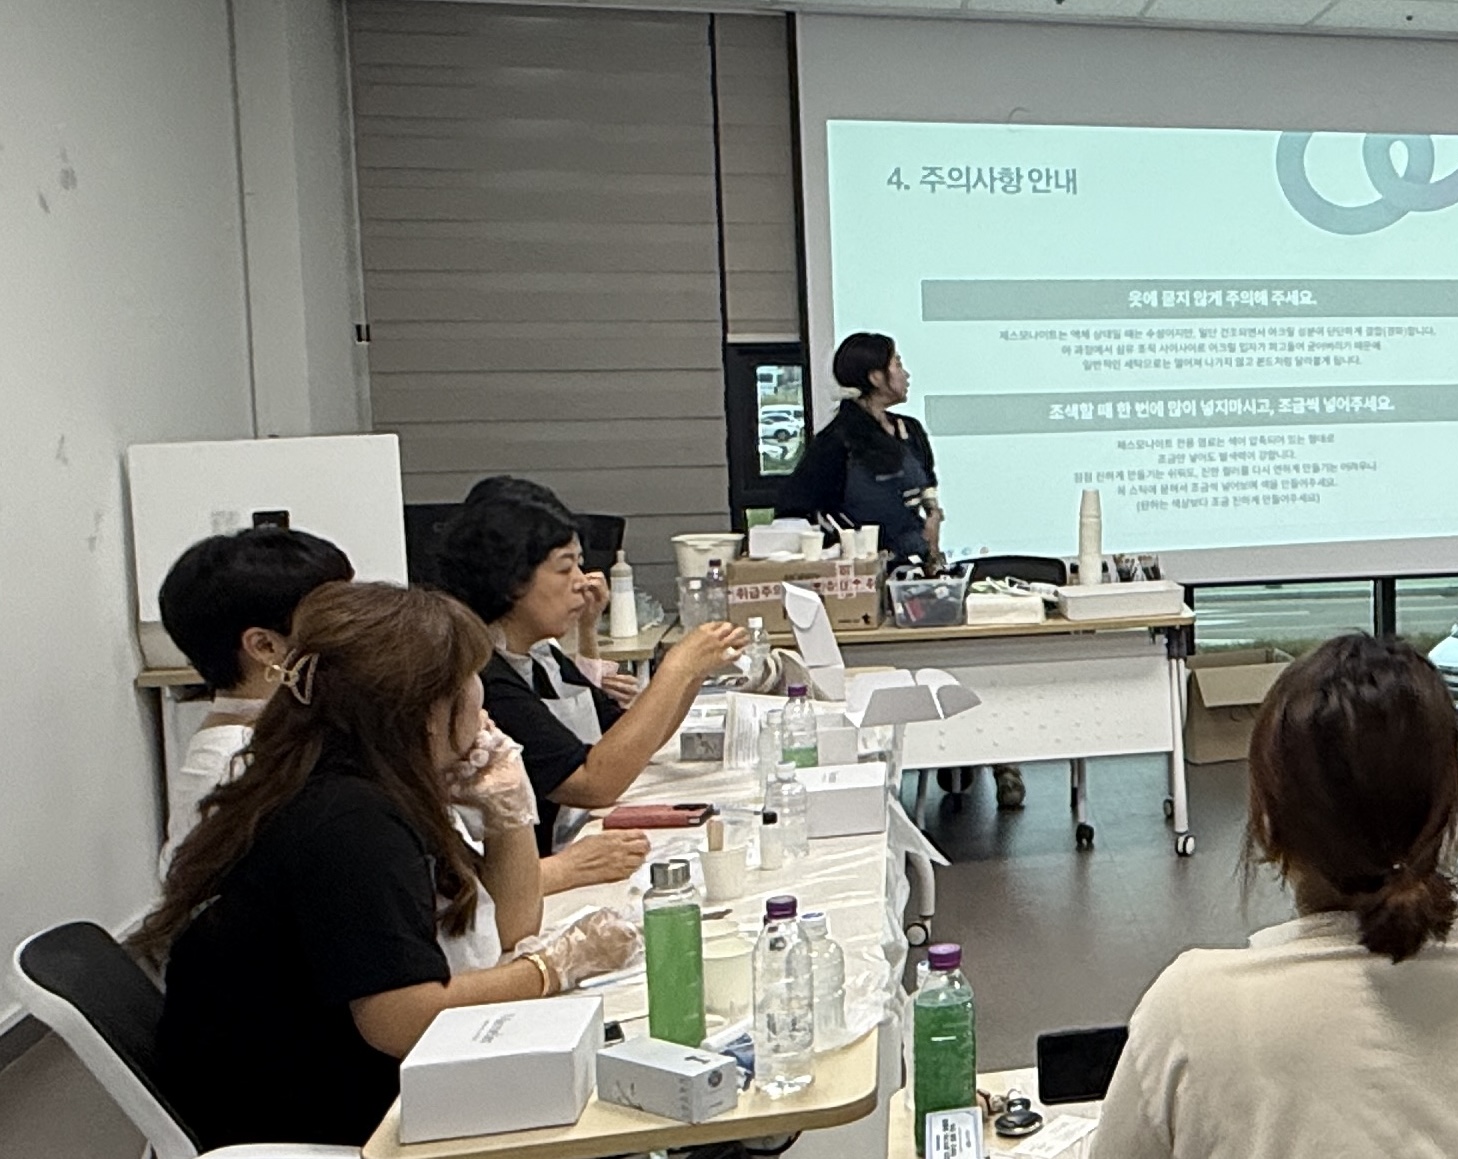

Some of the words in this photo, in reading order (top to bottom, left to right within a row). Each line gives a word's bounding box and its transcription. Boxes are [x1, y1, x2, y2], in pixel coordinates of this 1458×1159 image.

[887, 166, 911, 194] 4.
[919, 166, 1023, 195] 주의사항
[1027, 167, 1077, 195] 안내
[1128, 290, 1158, 307] 옷에
[1162, 290, 1189, 307] 묻지
[1193, 290, 1222, 307] 않게
[1226, 290, 1268, 306] 주의해
[1272, 290, 1317, 306] 주세요.
[1049, 402, 1094, 419] 조색할
[1098, 402, 1113, 418] 때
[1116, 401, 1131, 417] 한
[1135, 400, 1163, 417] 번에
[1168, 400, 1196, 416] 많이
[1201, 398, 1274, 415] 넣지마시고,
[1278, 397, 1319, 414] 조금씩
[1322, 395, 1394, 413] 넣어주세요.
